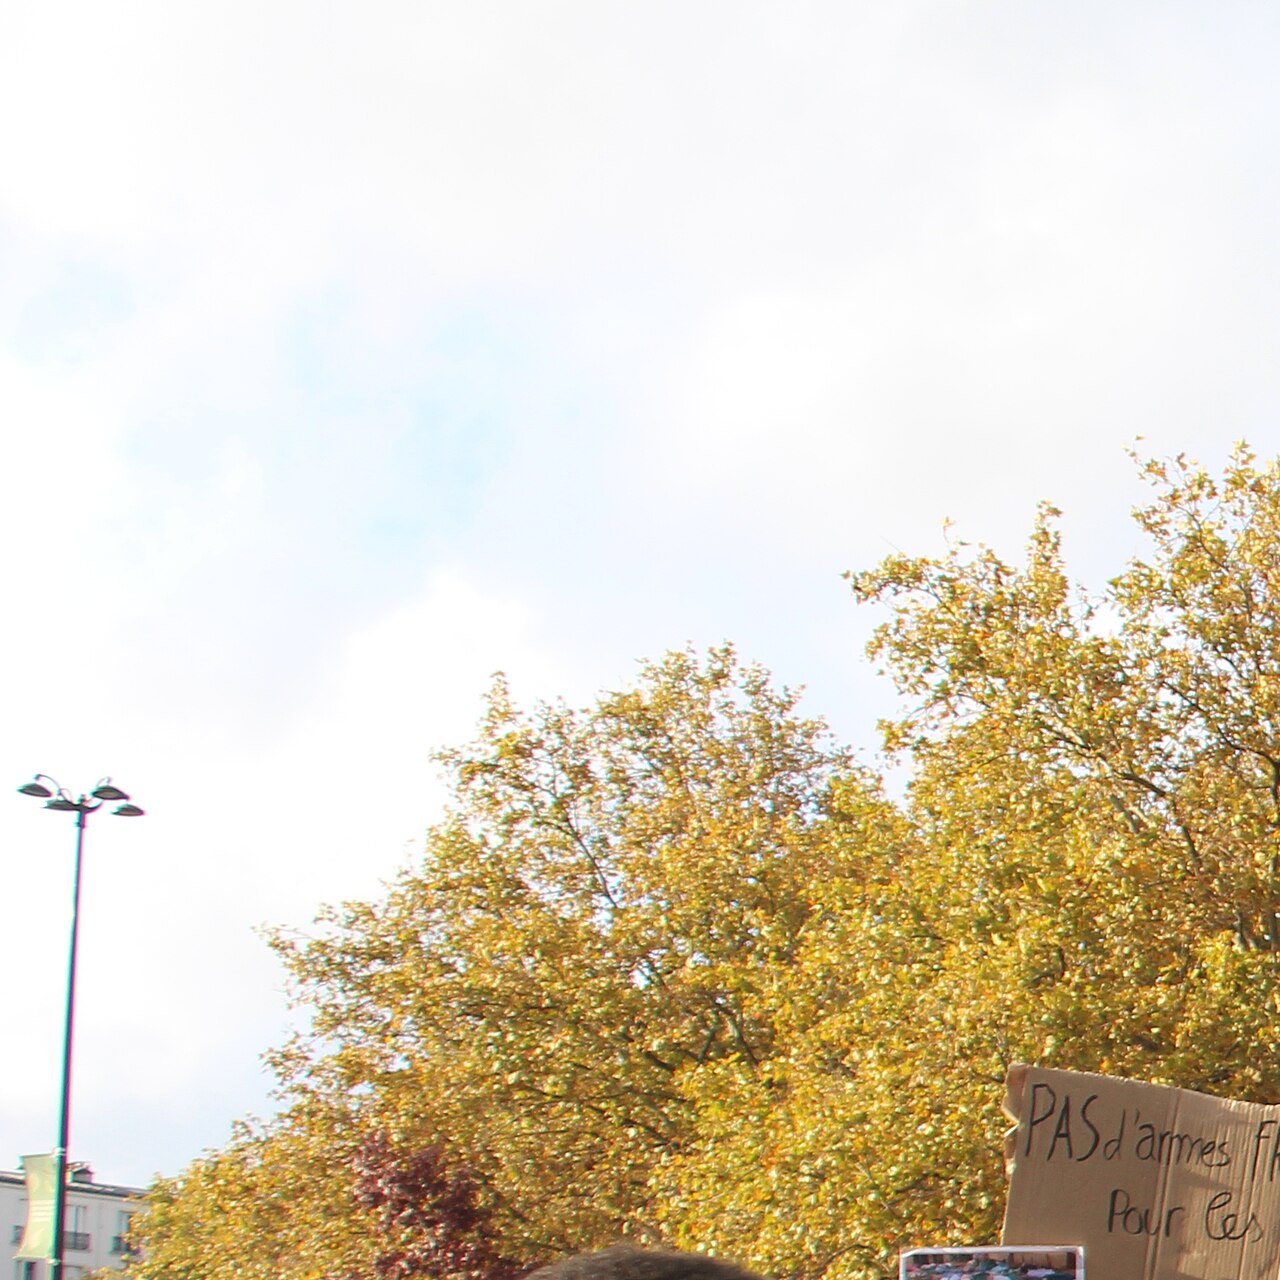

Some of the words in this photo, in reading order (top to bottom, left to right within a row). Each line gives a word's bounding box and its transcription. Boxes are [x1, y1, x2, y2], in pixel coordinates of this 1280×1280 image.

[1023, 1083, 1100, 1163] PAS
[1103, 1109, 1231, 1168] d'armes
[1106, 1188, 1187, 1237] Pour
[1204, 1191, 1265, 1244] les
